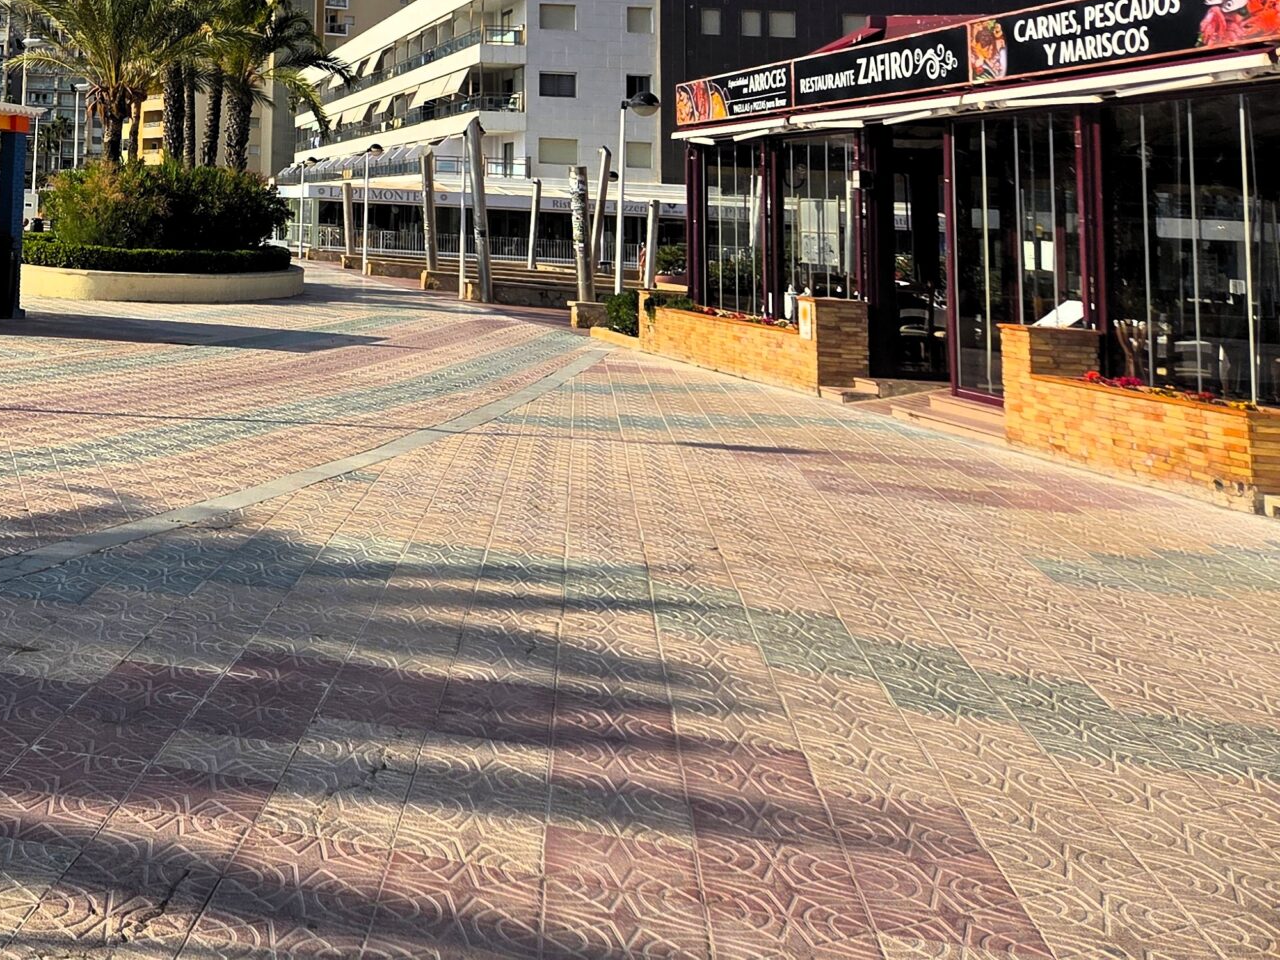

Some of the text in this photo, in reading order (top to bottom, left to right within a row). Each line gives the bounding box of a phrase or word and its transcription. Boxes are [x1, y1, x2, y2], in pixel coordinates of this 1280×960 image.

[1013, 9, 1082, 43] CARNES,
[1043, 25, 1149, 66] Y MARISCOS
[748, 67, 787, 93] ARROCES
[799, 48, 914, 94] RESTAURANTE ZAFIRO
[351, 189, 433, 202] PIMONTE
[552, 199, 600, 210] Ristn
[613, 202, 652, 214] zzeri
